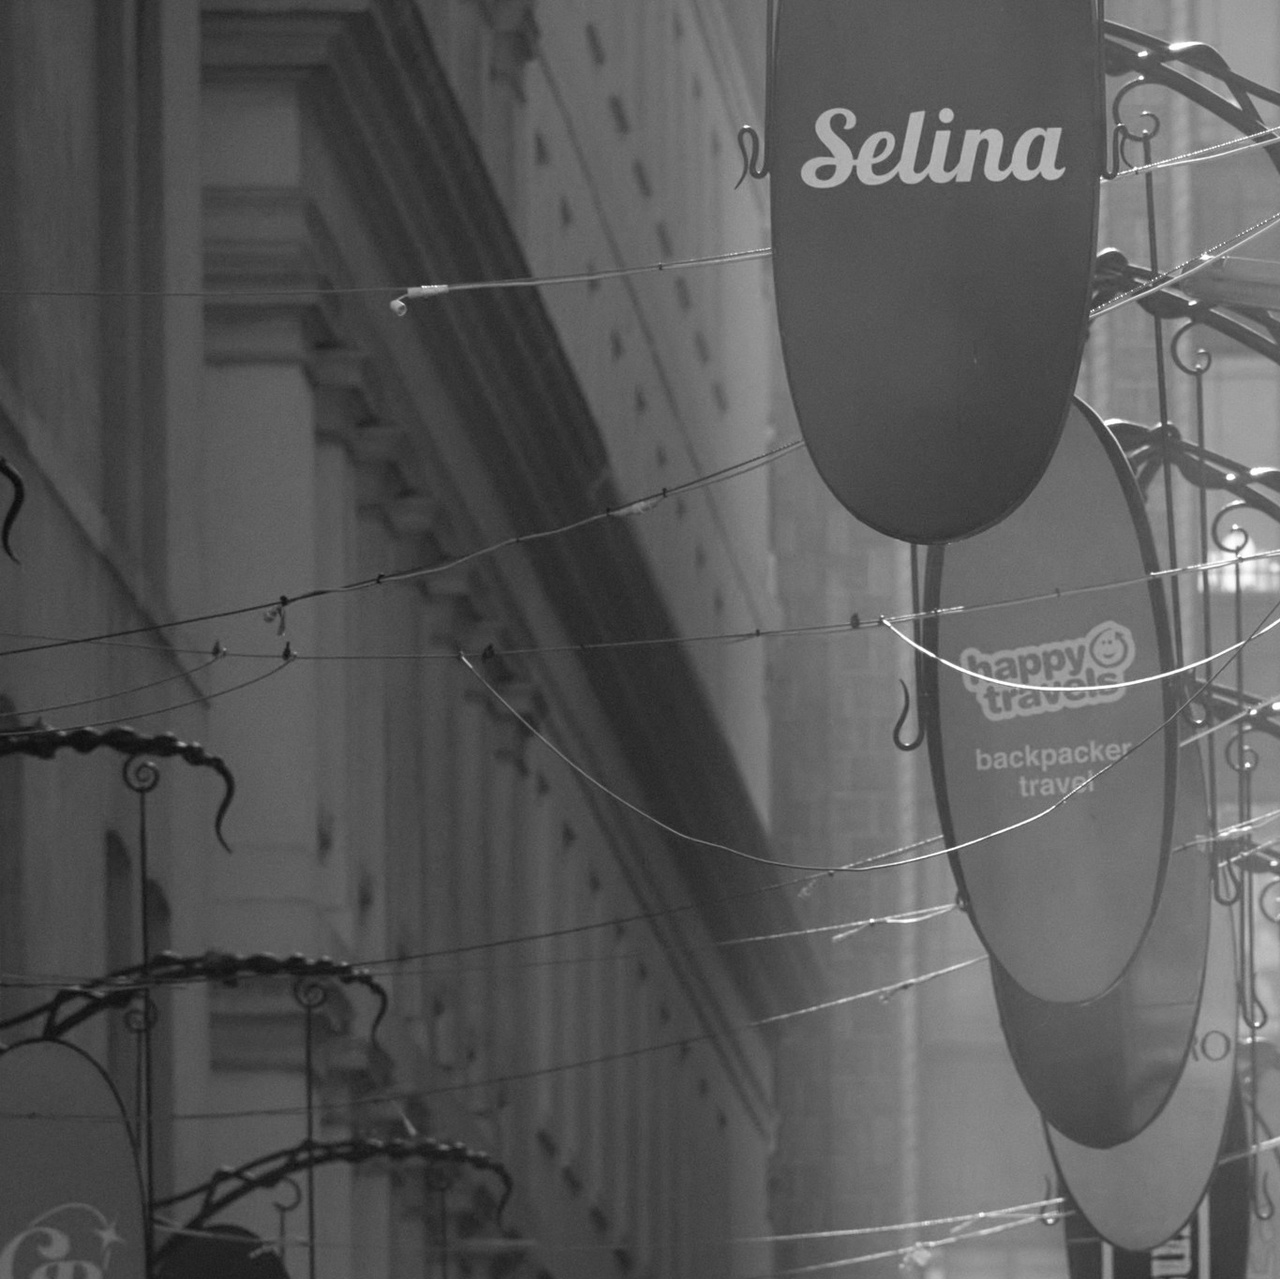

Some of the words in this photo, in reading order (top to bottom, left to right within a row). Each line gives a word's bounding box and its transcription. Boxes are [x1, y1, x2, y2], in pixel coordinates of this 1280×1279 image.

[799, 106, 1067, 189] Selina
[964, 643, 1086, 686] happy
[982, 666, 1120, 715] travels
[975, 740, 1133, 772] backpacker
[1018, 770, 1096, 798] travel
